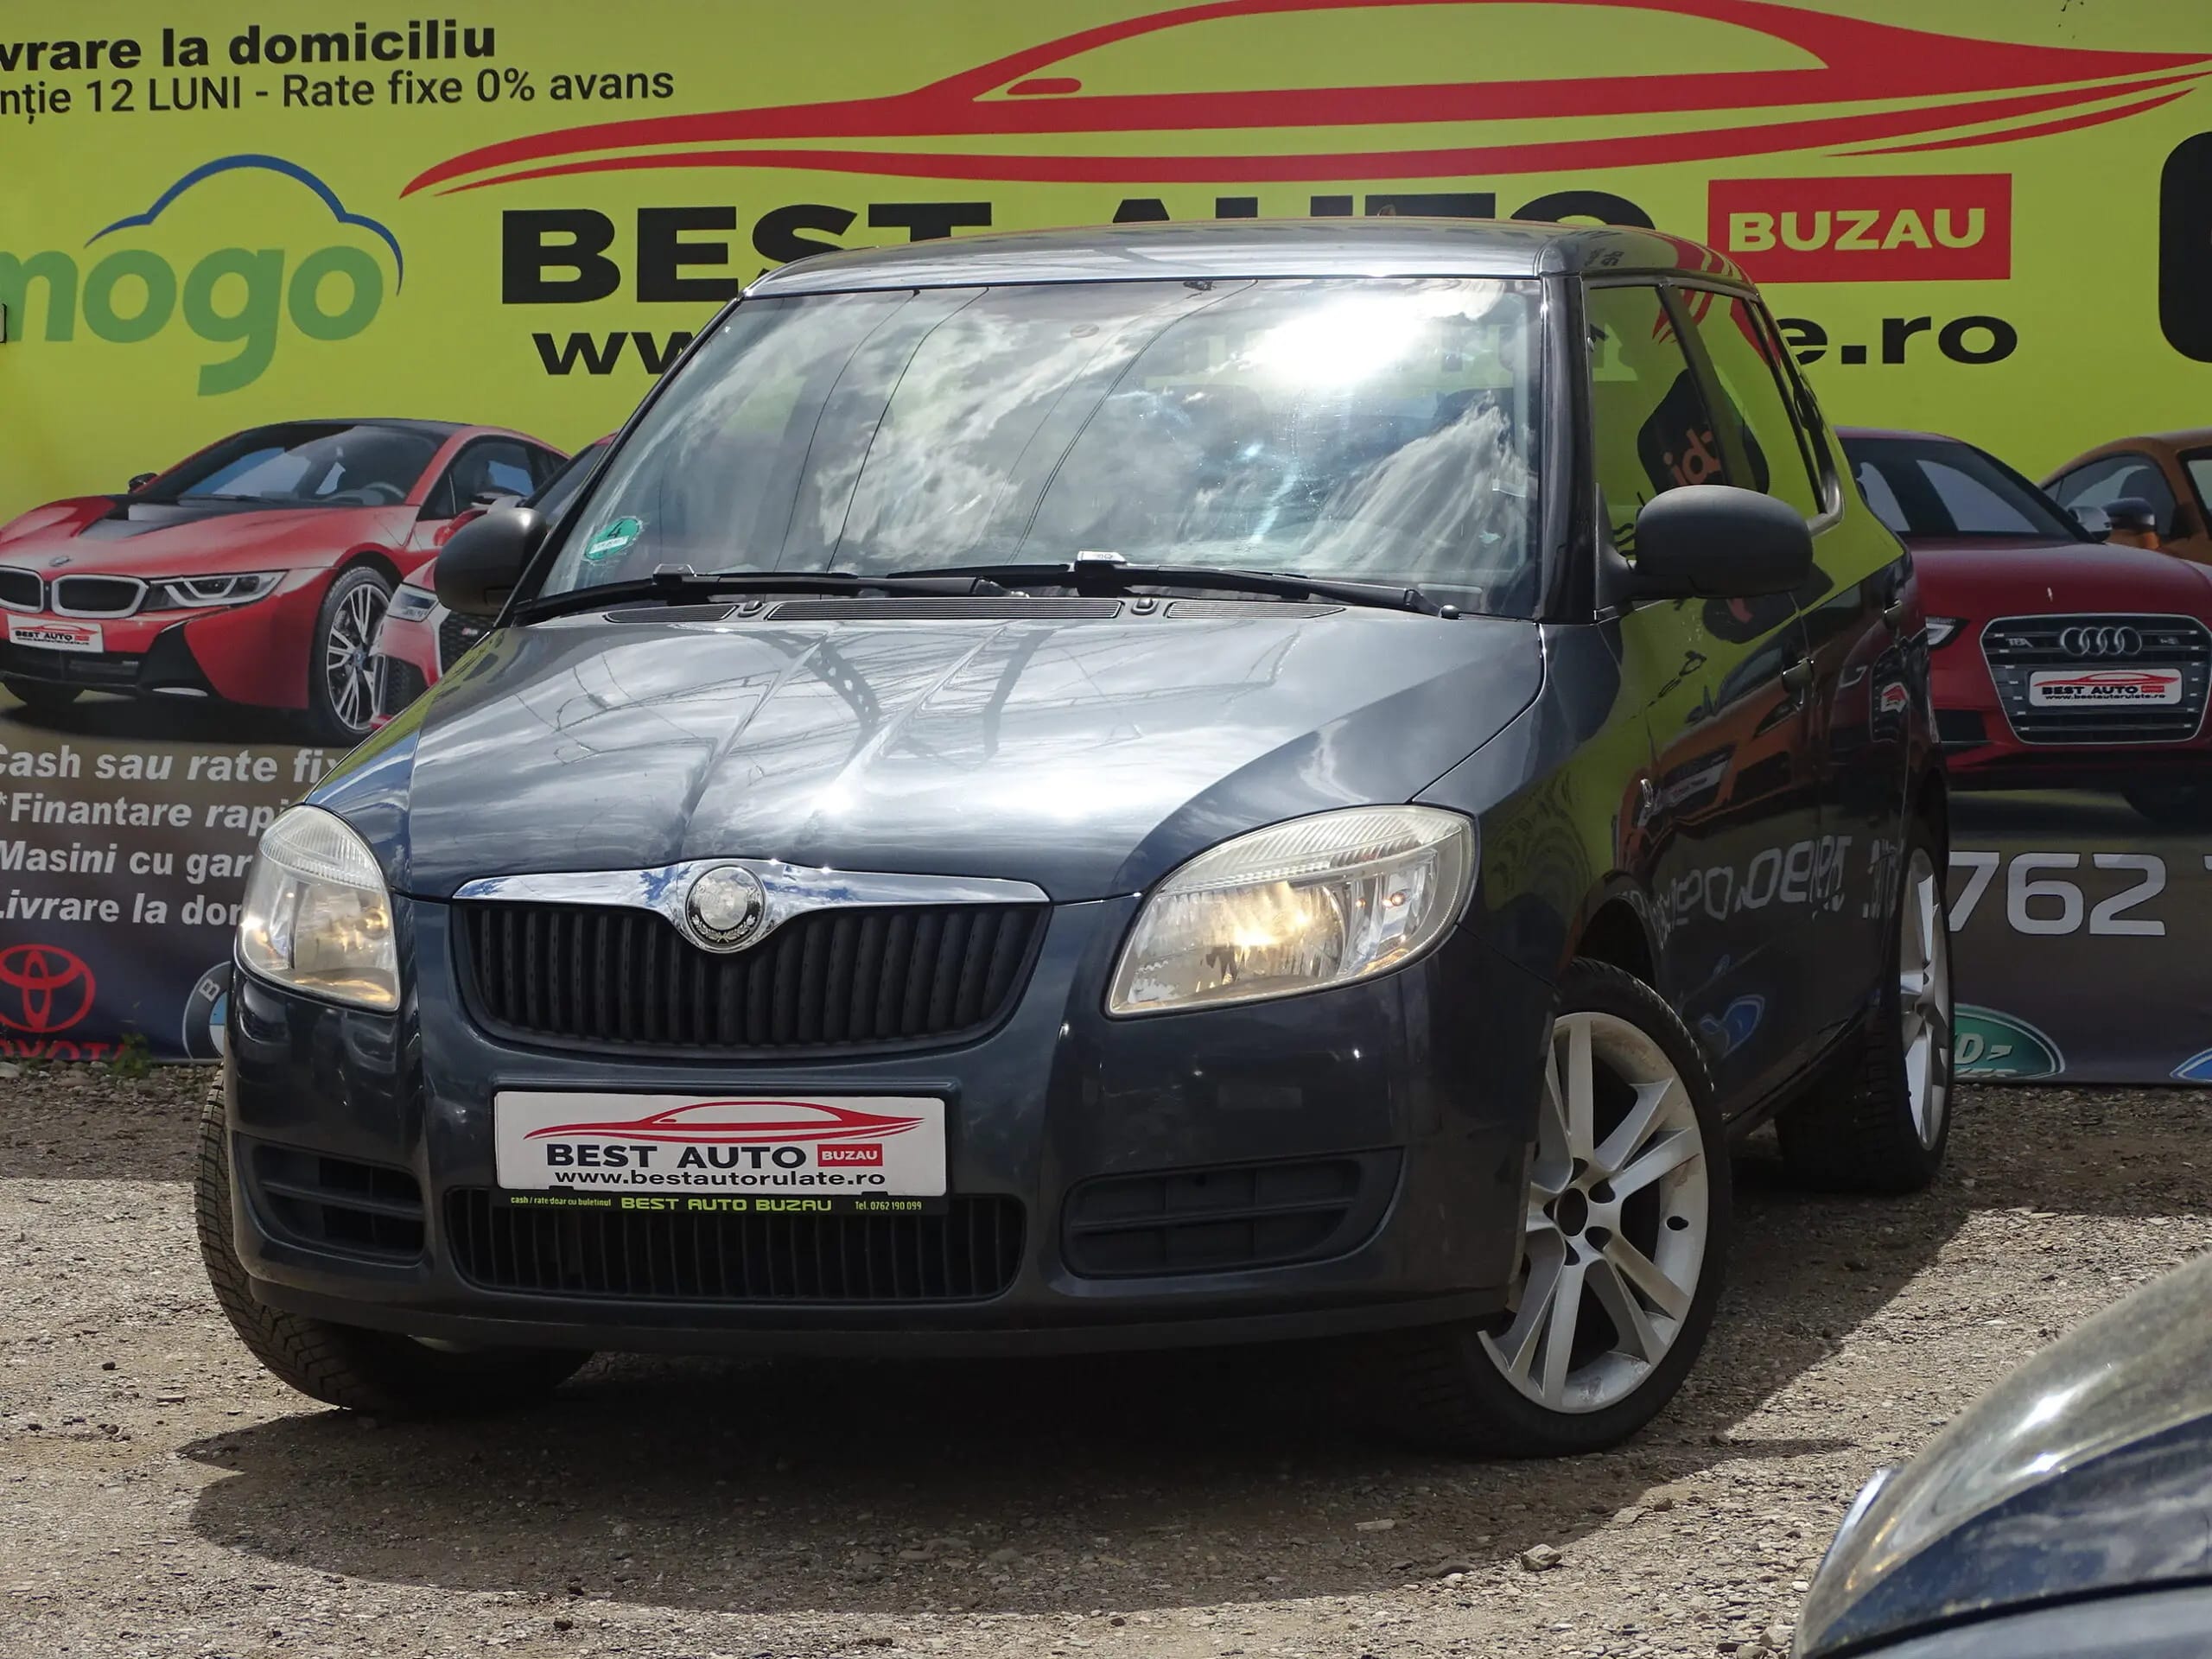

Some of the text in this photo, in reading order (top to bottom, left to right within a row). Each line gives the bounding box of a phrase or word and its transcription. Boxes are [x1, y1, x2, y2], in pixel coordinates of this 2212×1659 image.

[162, 29, 209, 67] la
[229, 19, 495, 65] domiciliu
[86, 79, 134, 112] 12
[149, 76, 241, 111] LUNI
[283, 74, 375, 108] Rate
[388, 69, 463, 105] fixe
[477, 67, 536, 103] 0%
[550, 71, 675, 101] avans
[1728, 207, 1986, 252] BUZAU
[0, 245, 384, 397] mogo
[44, 632, 73, 641] AUTO
[2042, 686, 2085, 695] BEST
[2091, 686, 2139, 695] AUTO
[95, 753, 173, 780] sau
[187, 749, 278, 782] rate
[130, 851, 173, 875] cu
[1948, 851, 2166, 935] 762
[132, 893, 168, 925] la
[546, 1143, 878, 1169] BEST AUTO BUZAU
[555, 1170, 886, 1186] www.bestautorulate.ro
[511, 1196, 529, 1205] cash
[534, 1197, 549, 1205] rate
[550, 1197, 567, 1205] doar
[621, 1197, 832, 1211] BEST AUTO BUZAU
[855, 1200, 922, 1211] Tel. 0762 190 099
